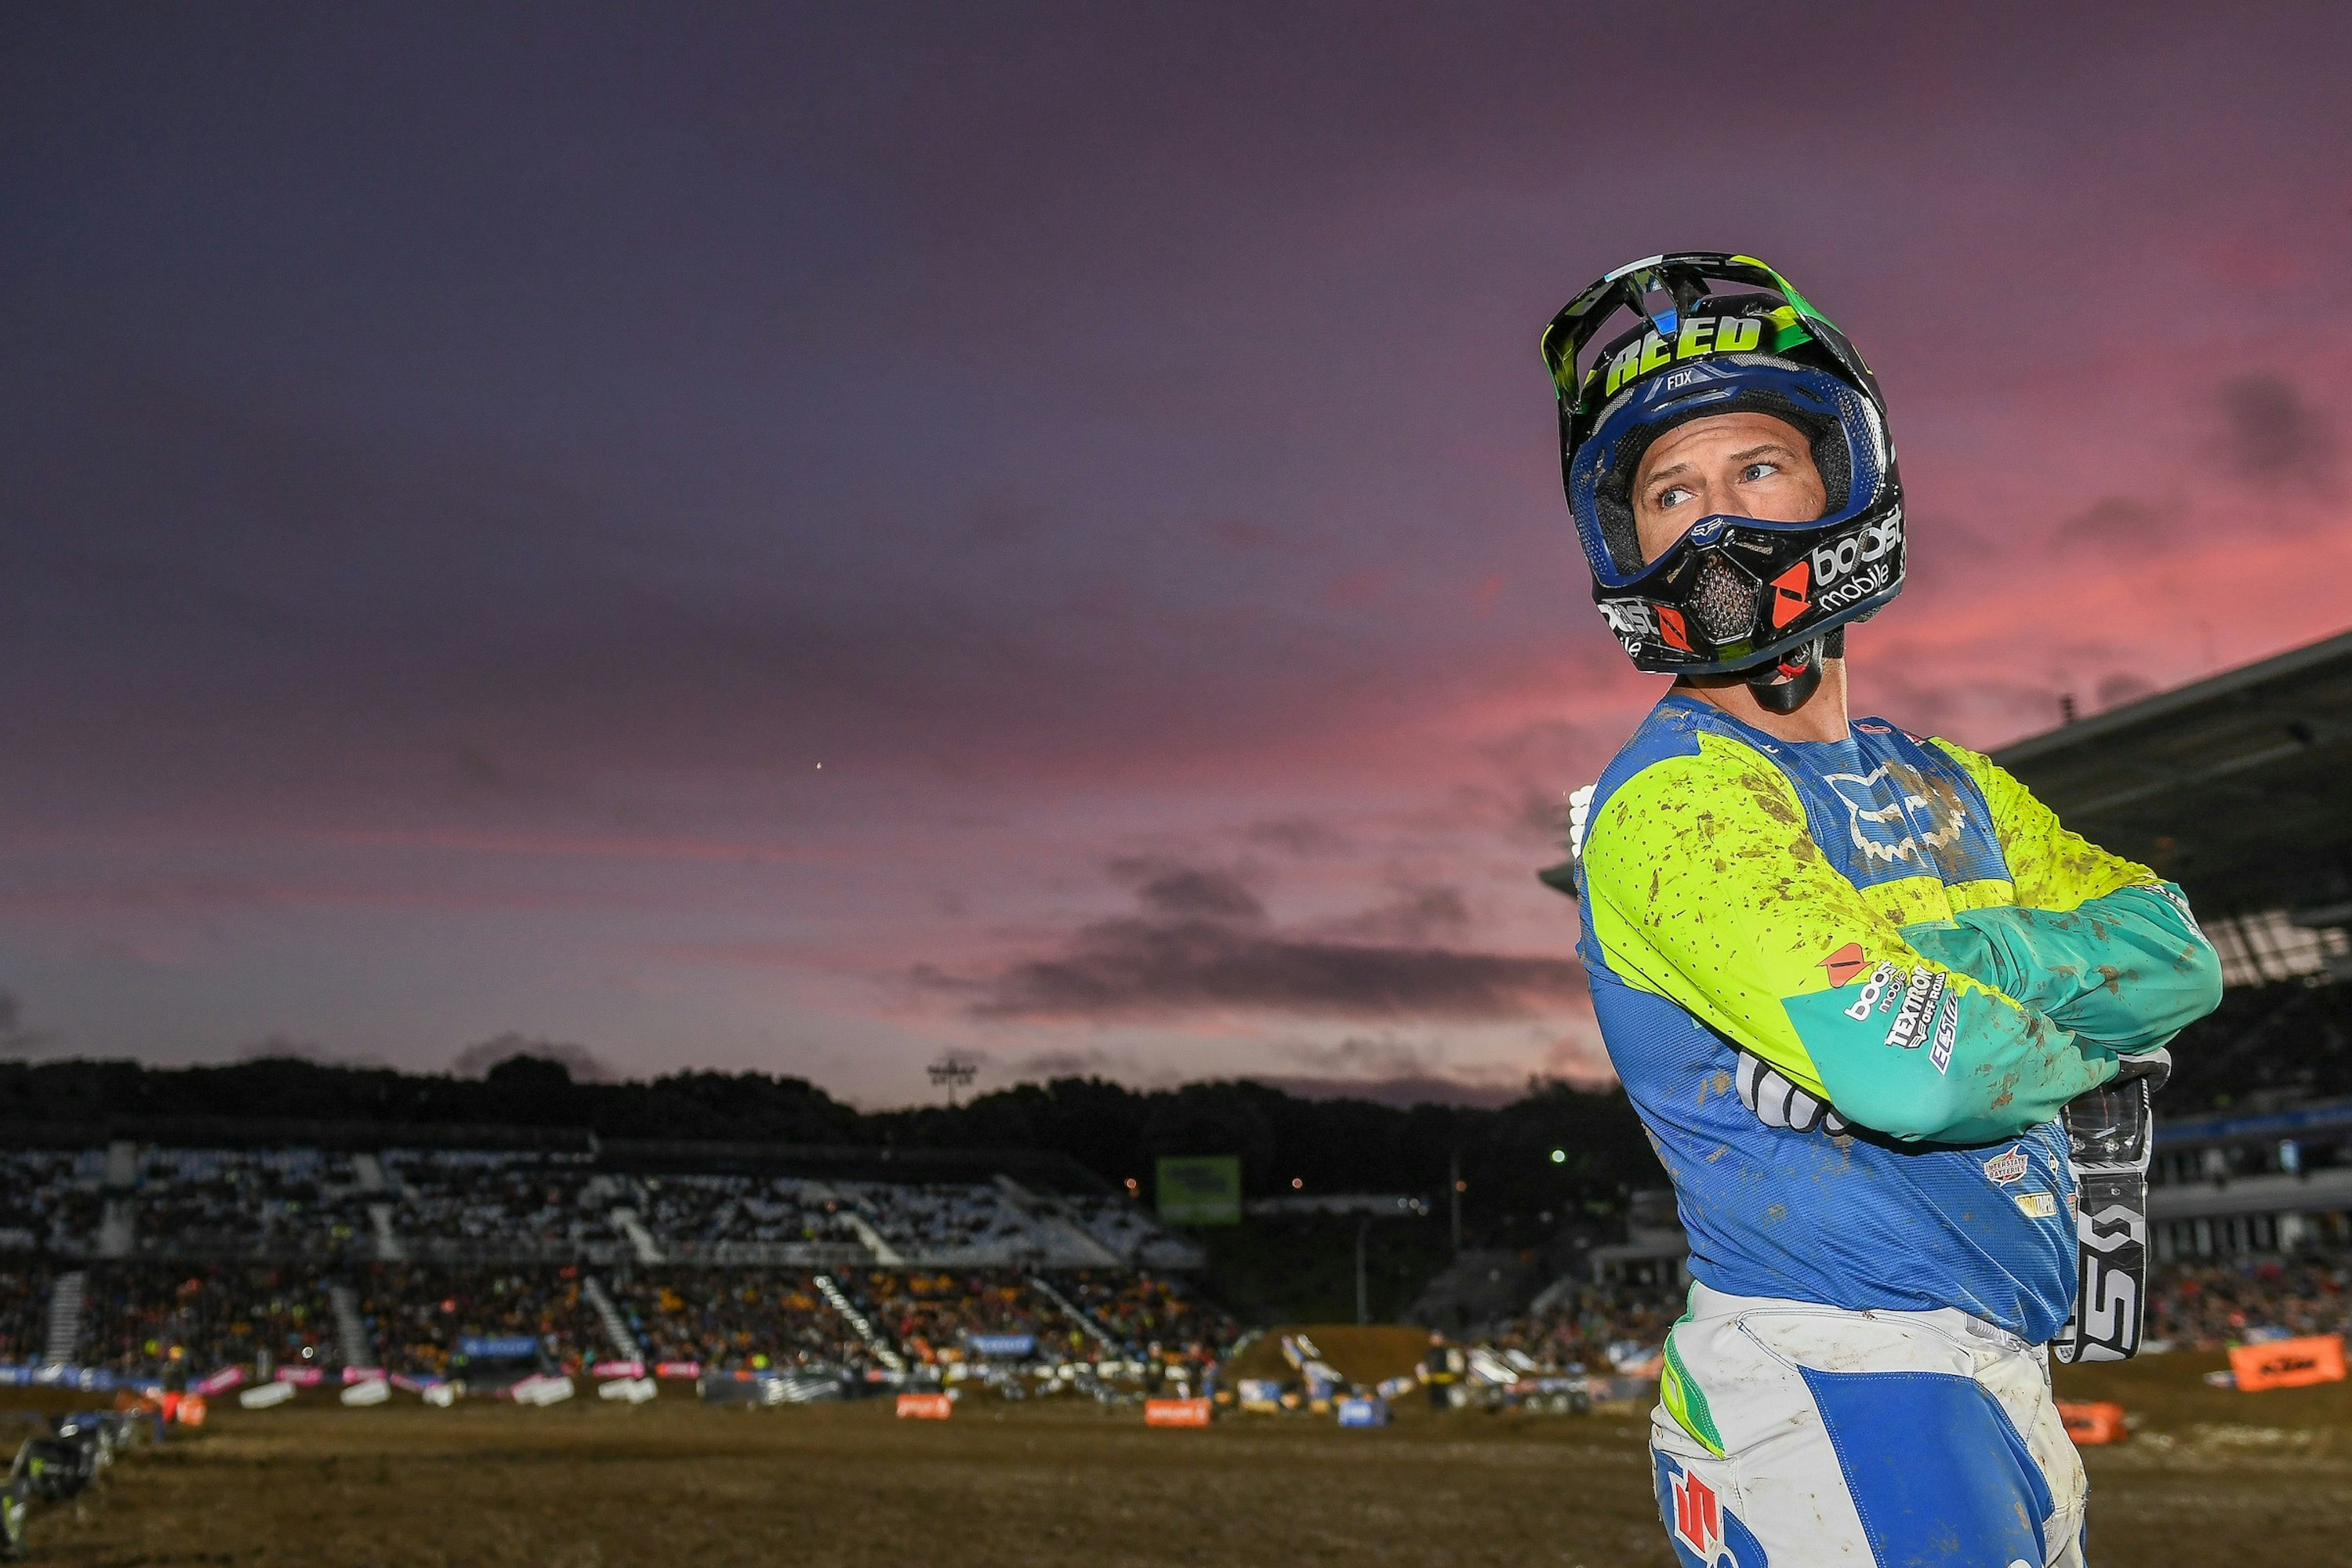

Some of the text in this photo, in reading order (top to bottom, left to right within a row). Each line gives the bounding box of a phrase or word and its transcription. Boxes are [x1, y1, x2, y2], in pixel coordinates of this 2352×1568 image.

[1606, 316, 1762, 397] REED
[1667, 370, 1693, 391] FOX
[1812, 503, 1902, 587] boost
[1818, 563, 1889, 612] mobile
[1843, 960, 1900, 1022] boost
[1878, 971, 1907, 1014] mobile
[1884, 964, 1934, 1047] TEXTRON
[1923, 971, 1946, 1024] OFF ROAD
[1985, 1158, 2026, 1172] INTERSTATE
[1990, 1166, 2024, 1178] BATTERIES
